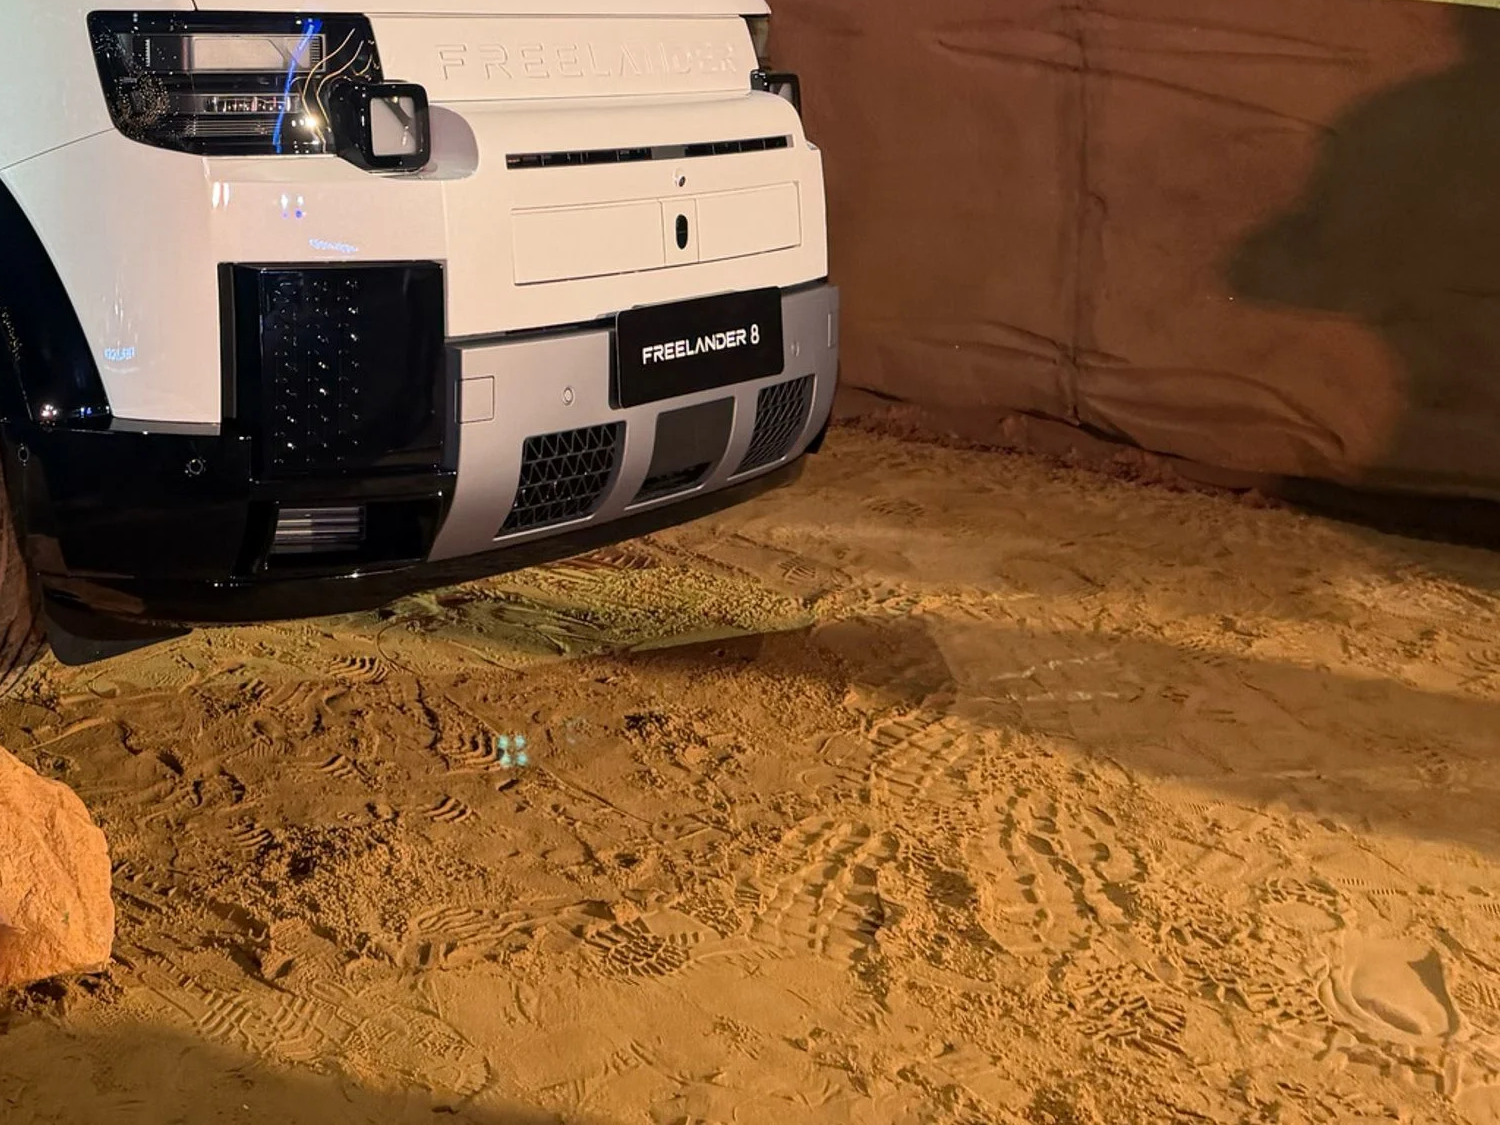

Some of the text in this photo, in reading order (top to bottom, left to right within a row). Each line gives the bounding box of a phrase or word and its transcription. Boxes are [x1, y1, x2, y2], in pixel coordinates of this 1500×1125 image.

[435, 42, 738, 80] FREELANDER
[641, 323, 760, 365] FREELANDER 8
